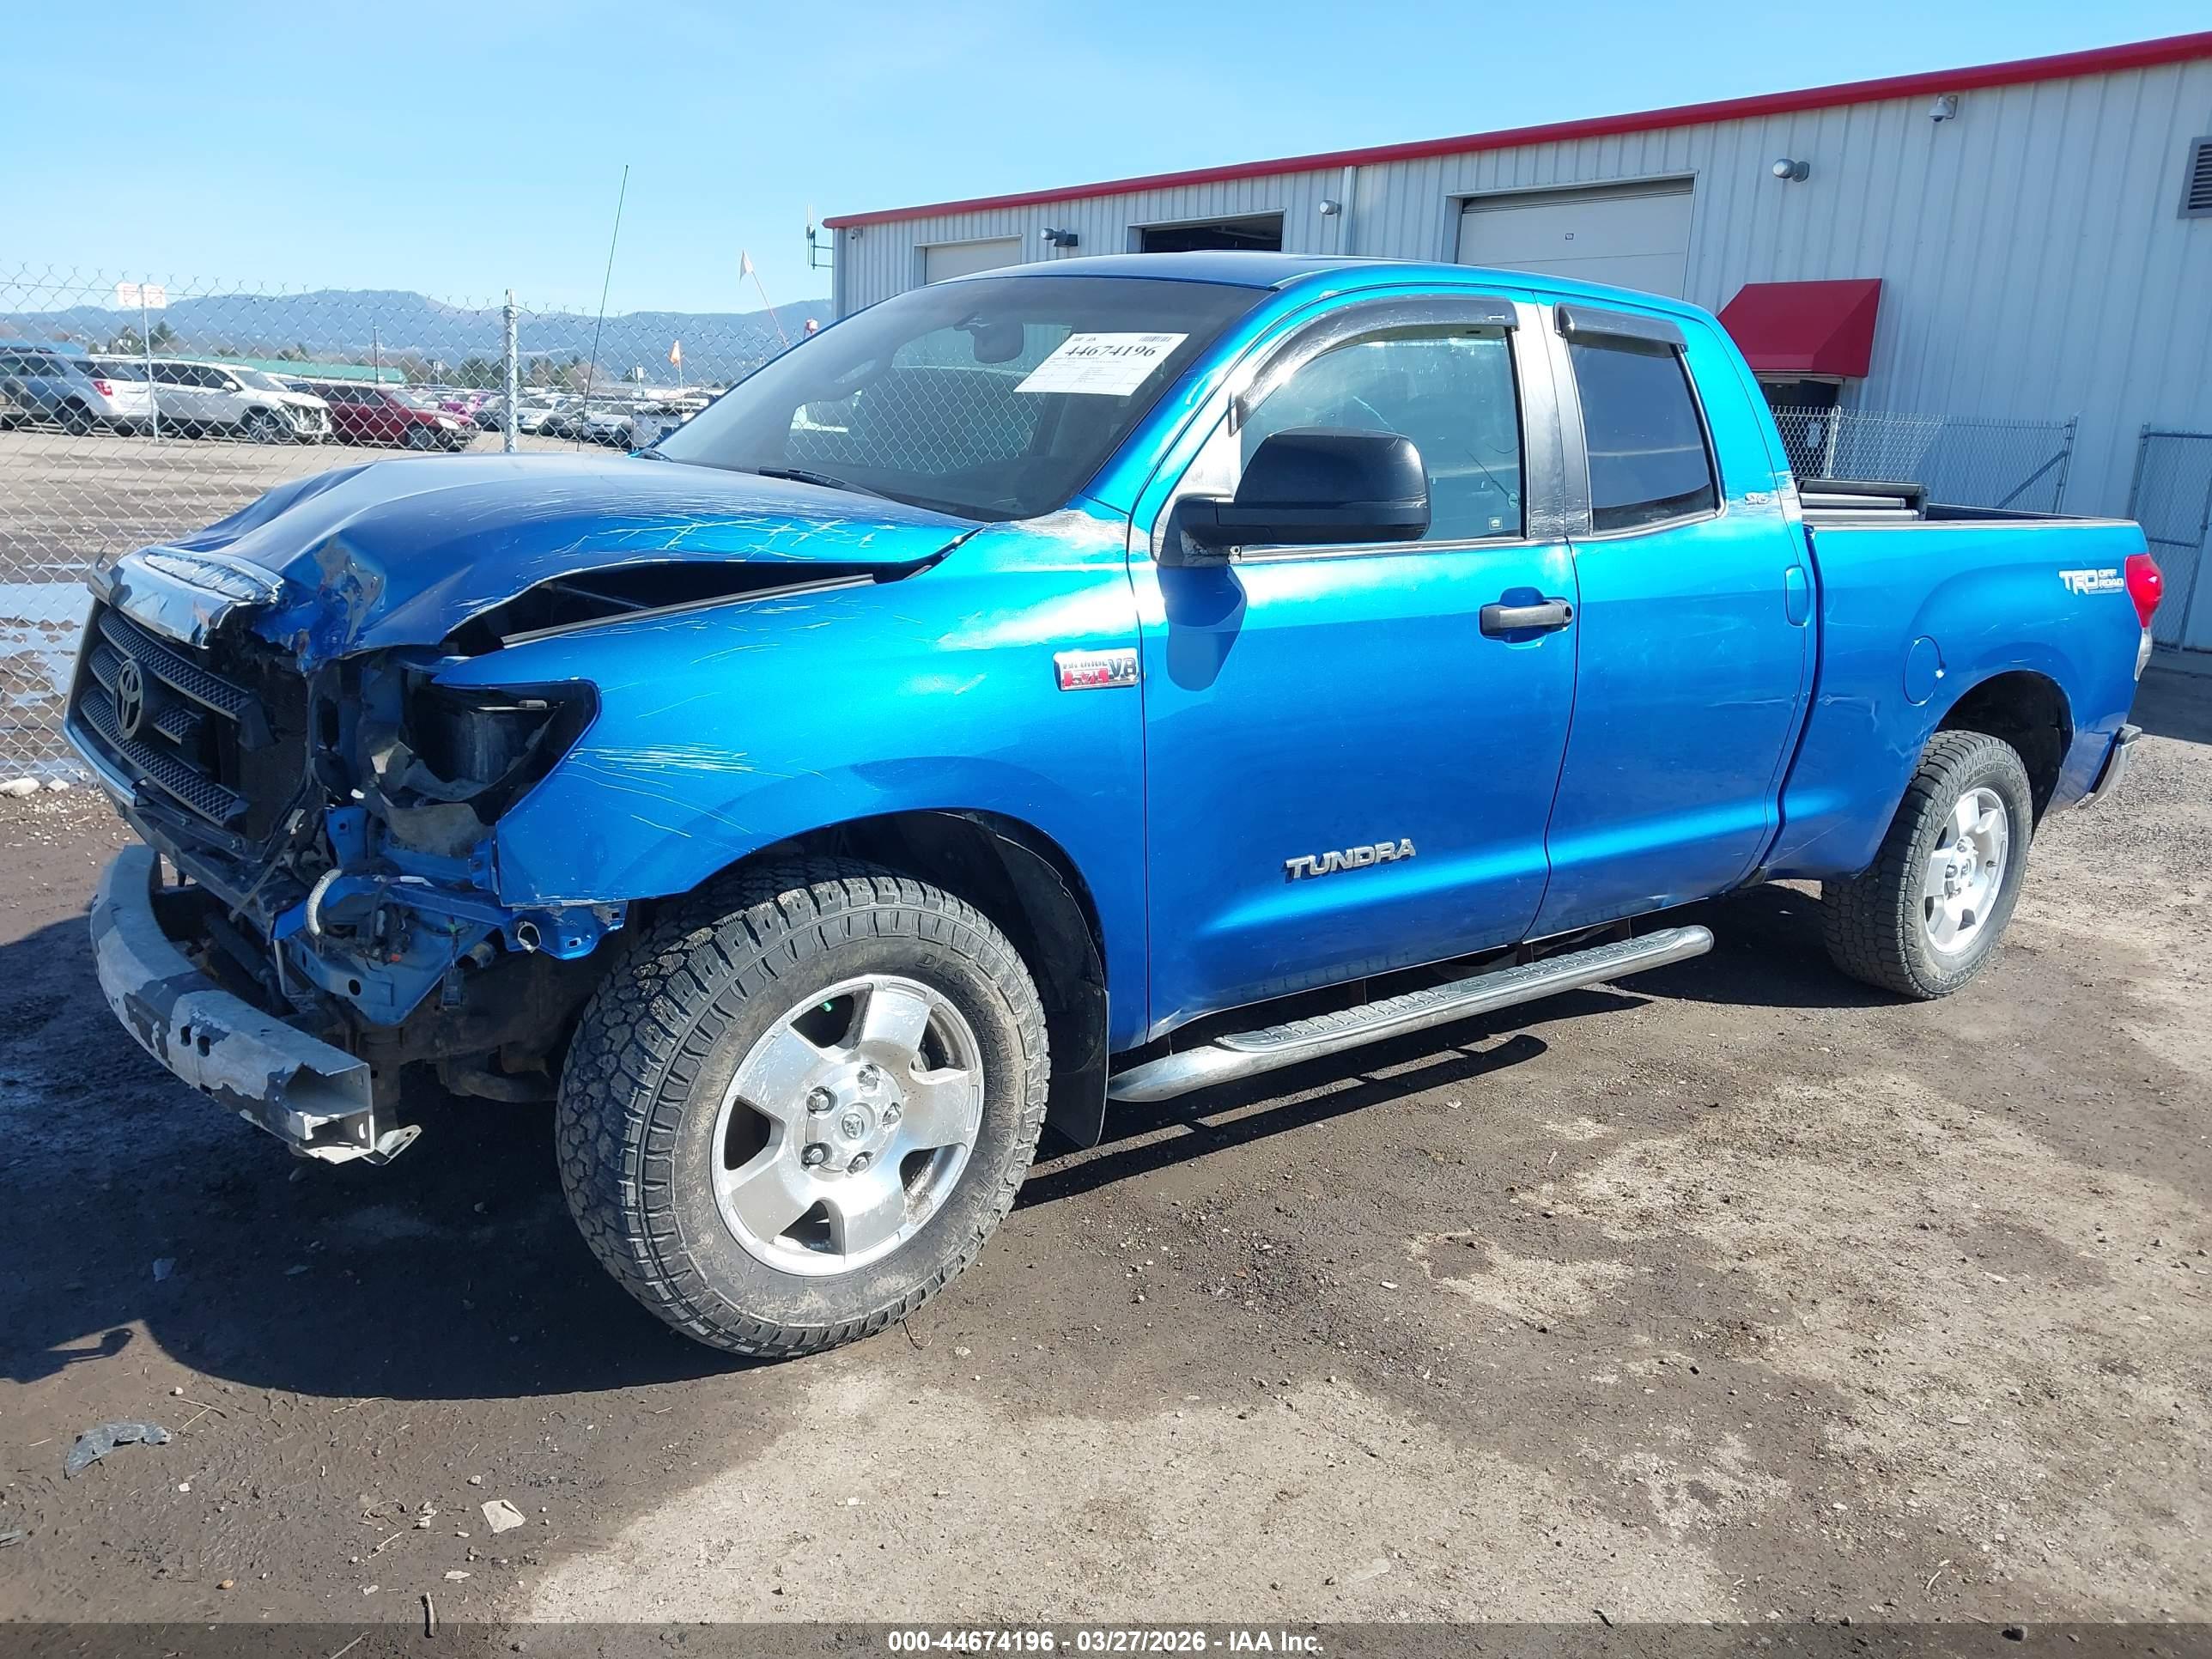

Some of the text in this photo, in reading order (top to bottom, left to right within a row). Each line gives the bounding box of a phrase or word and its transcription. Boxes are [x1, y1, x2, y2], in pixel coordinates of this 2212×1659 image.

[1064, 345, 1162, 357] 44674196
[2098, 568, 2118, 577] OFF
[2058, 569, 2099, 595] TRD
[2100, 578, 2124, 587] ROAD
[1108, 657, 1137, 680] V8
[1285, 838, 1416, 878] TUNDRA
